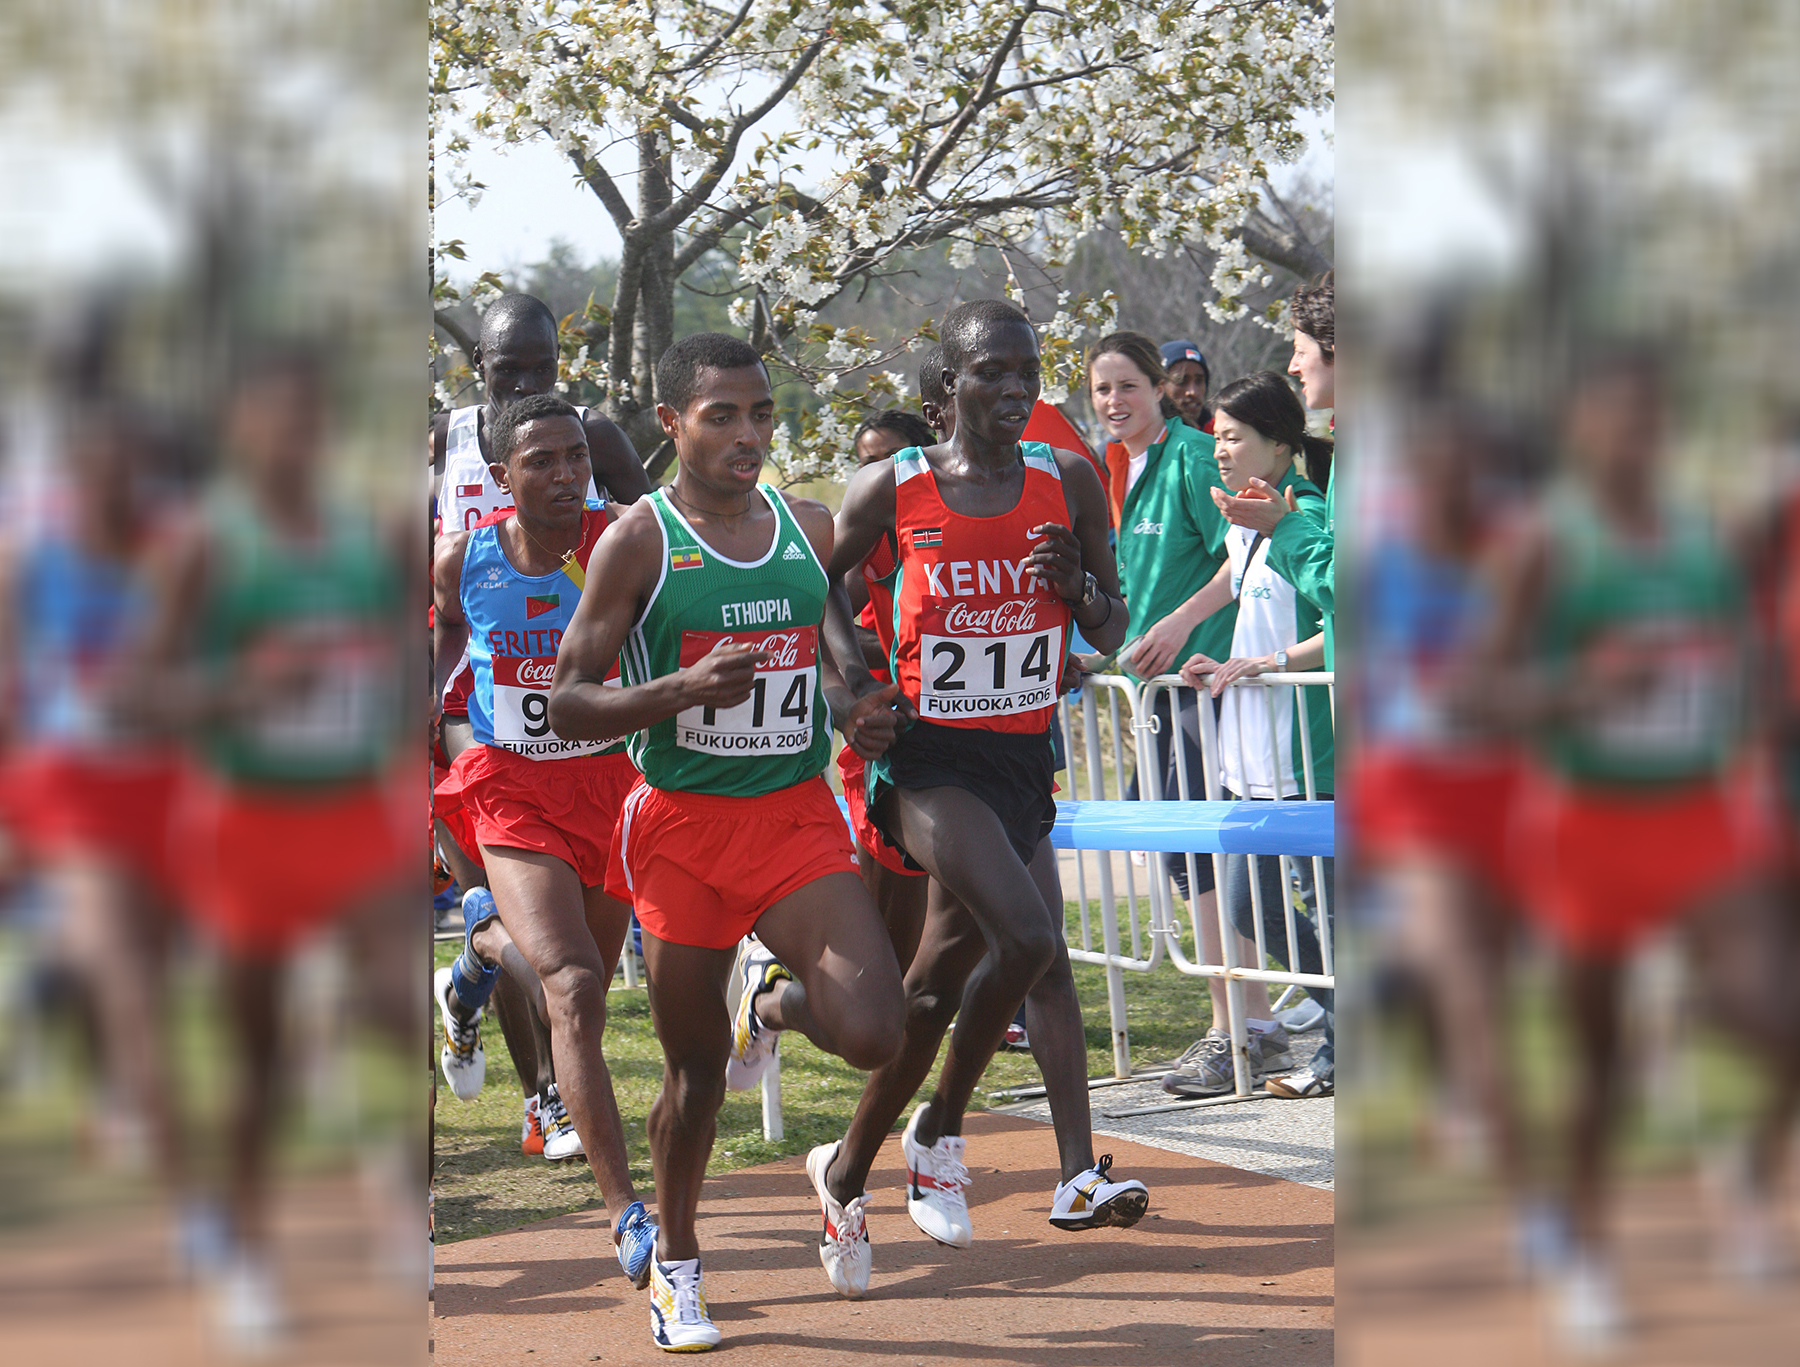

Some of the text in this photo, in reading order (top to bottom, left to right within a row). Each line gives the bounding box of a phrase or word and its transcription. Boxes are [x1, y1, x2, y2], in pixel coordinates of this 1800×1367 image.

[783, 551, 806, 560] adidas
[923, 559, 1050, 598] KENYA
[721, 598, 792, 628] ETHIOPIA
[945, 598, 1039, 634] Coca-Cola
[932, 634, 1051, 690] 214
[928, 688, 1050, 713] FUKUOKA 2006
[685, 730, 808, 749] FUKUOKA 2006
